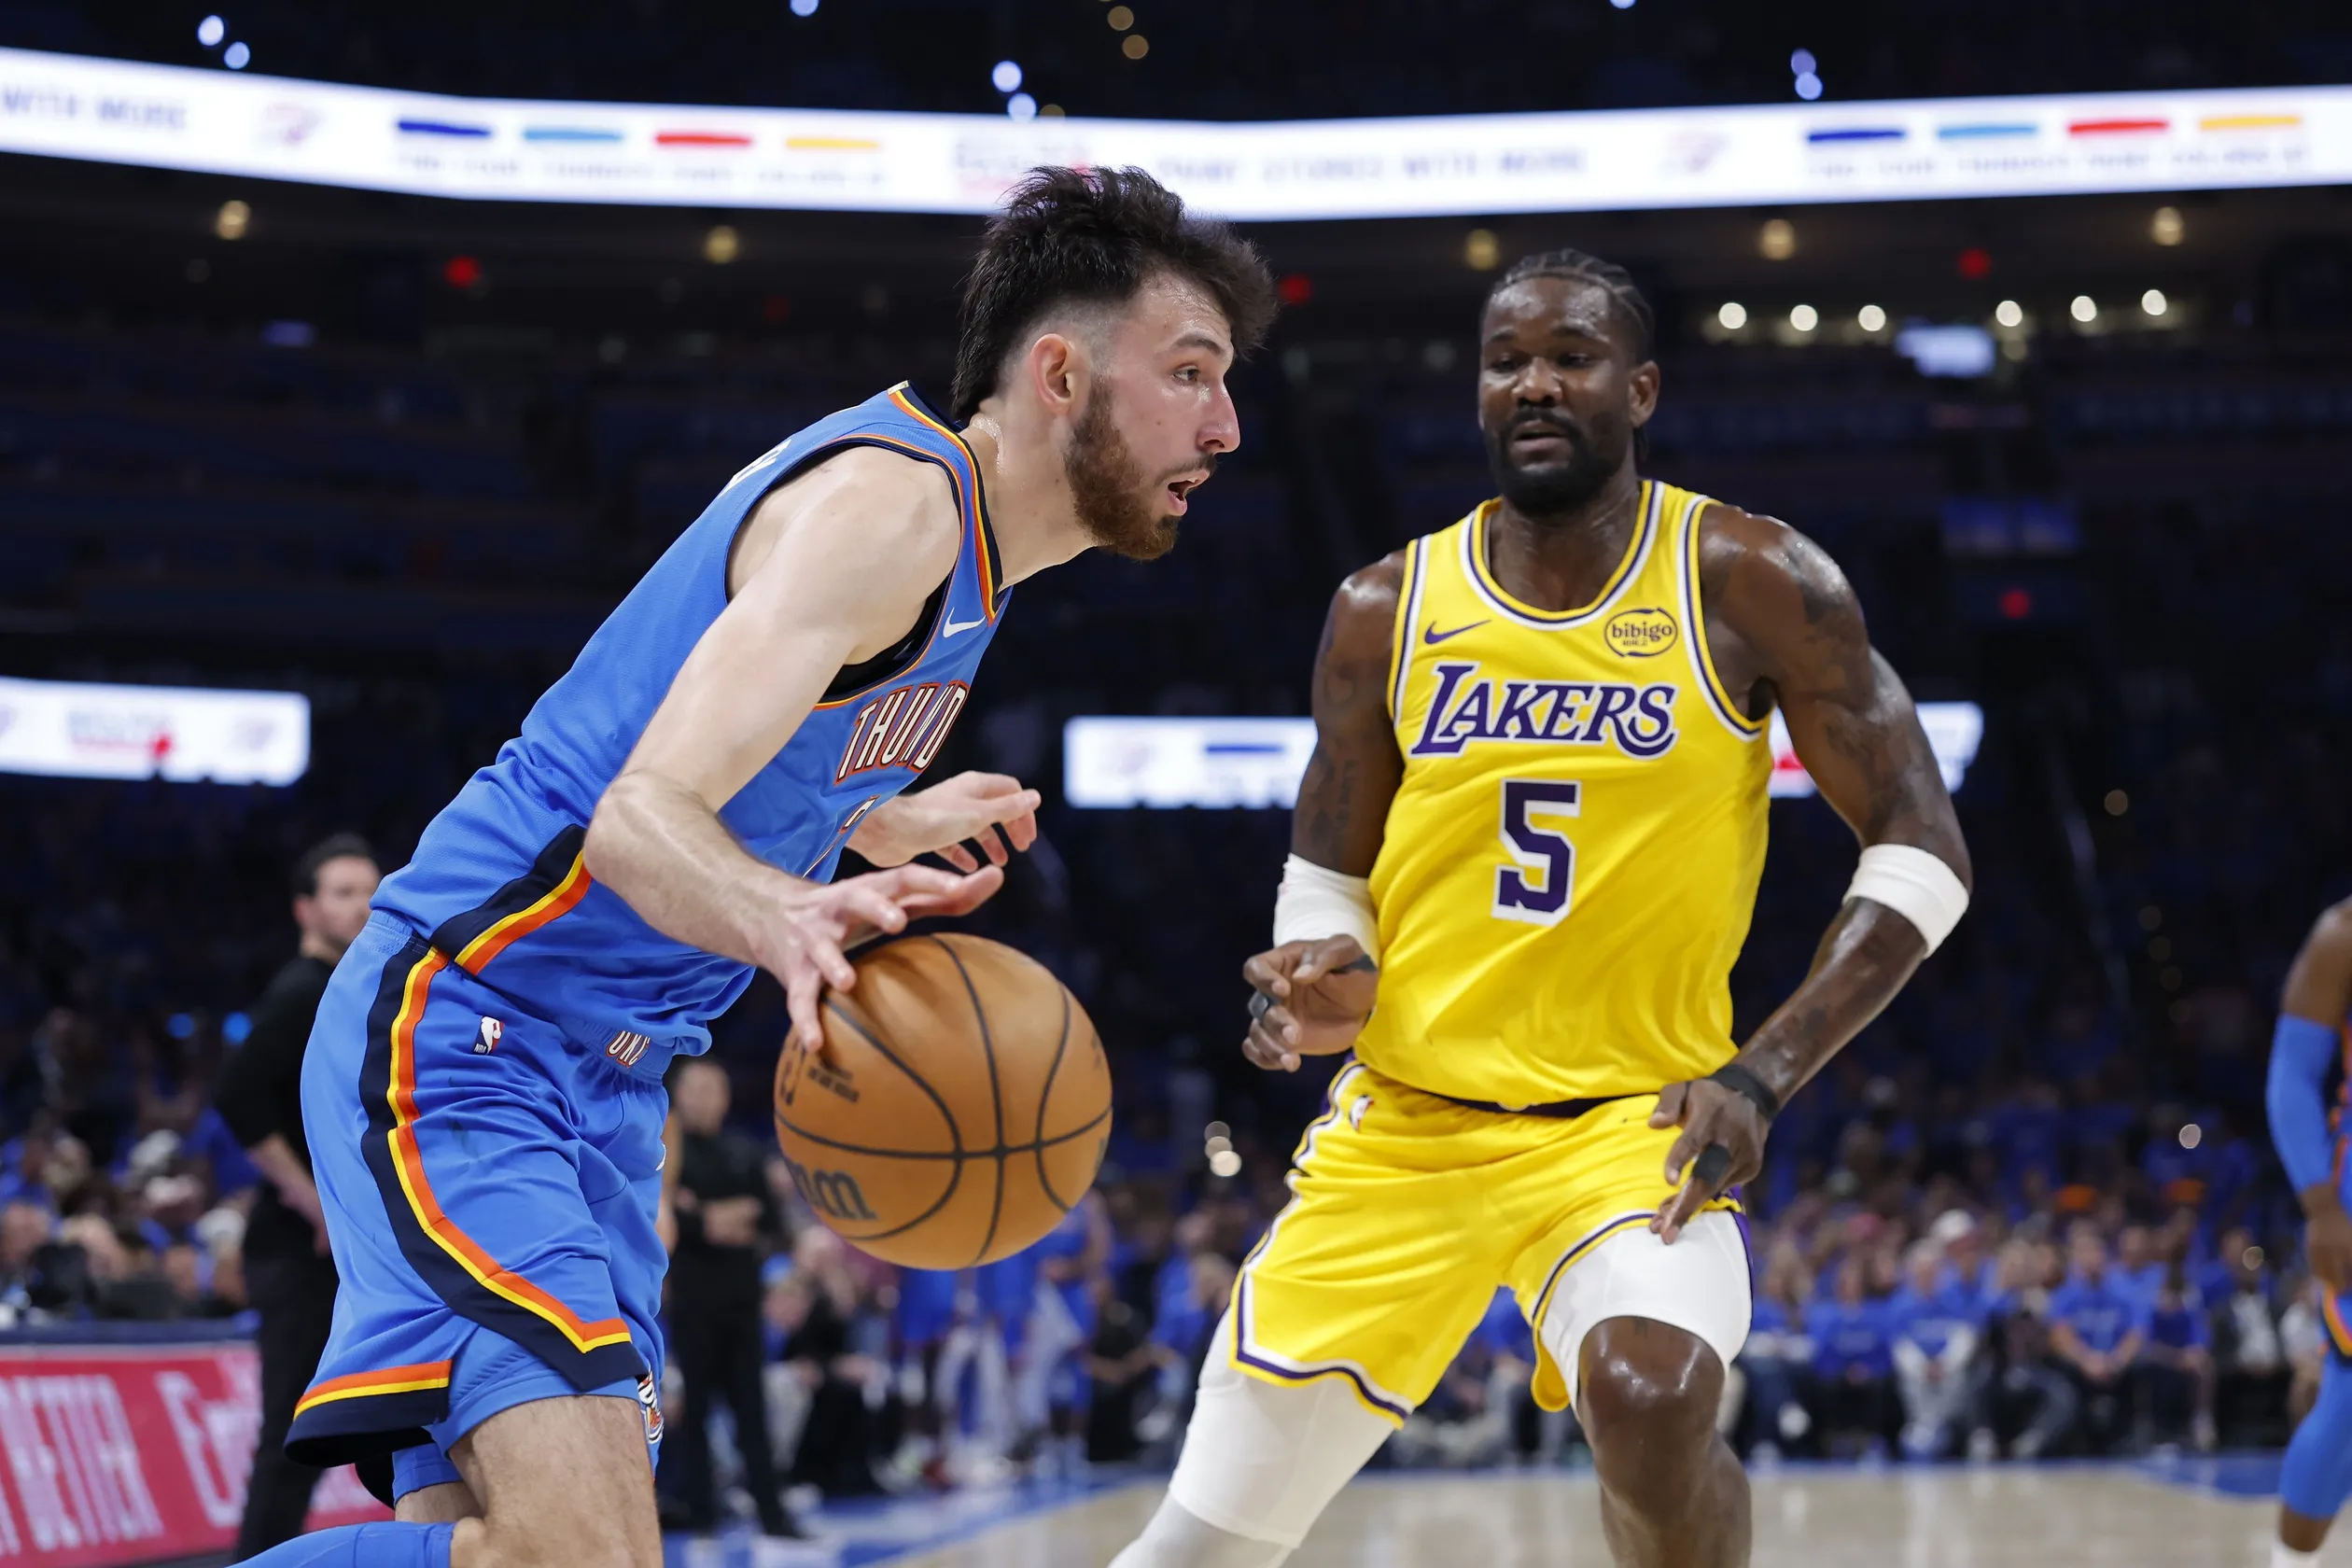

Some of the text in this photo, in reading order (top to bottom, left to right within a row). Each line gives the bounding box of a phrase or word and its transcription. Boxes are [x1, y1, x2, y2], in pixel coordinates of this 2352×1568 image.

[1612, 622, 1673, 642] bibigo
[1408, 661, 1679, 760] LAKERS
[1491, 777, 1581, 928] 5
